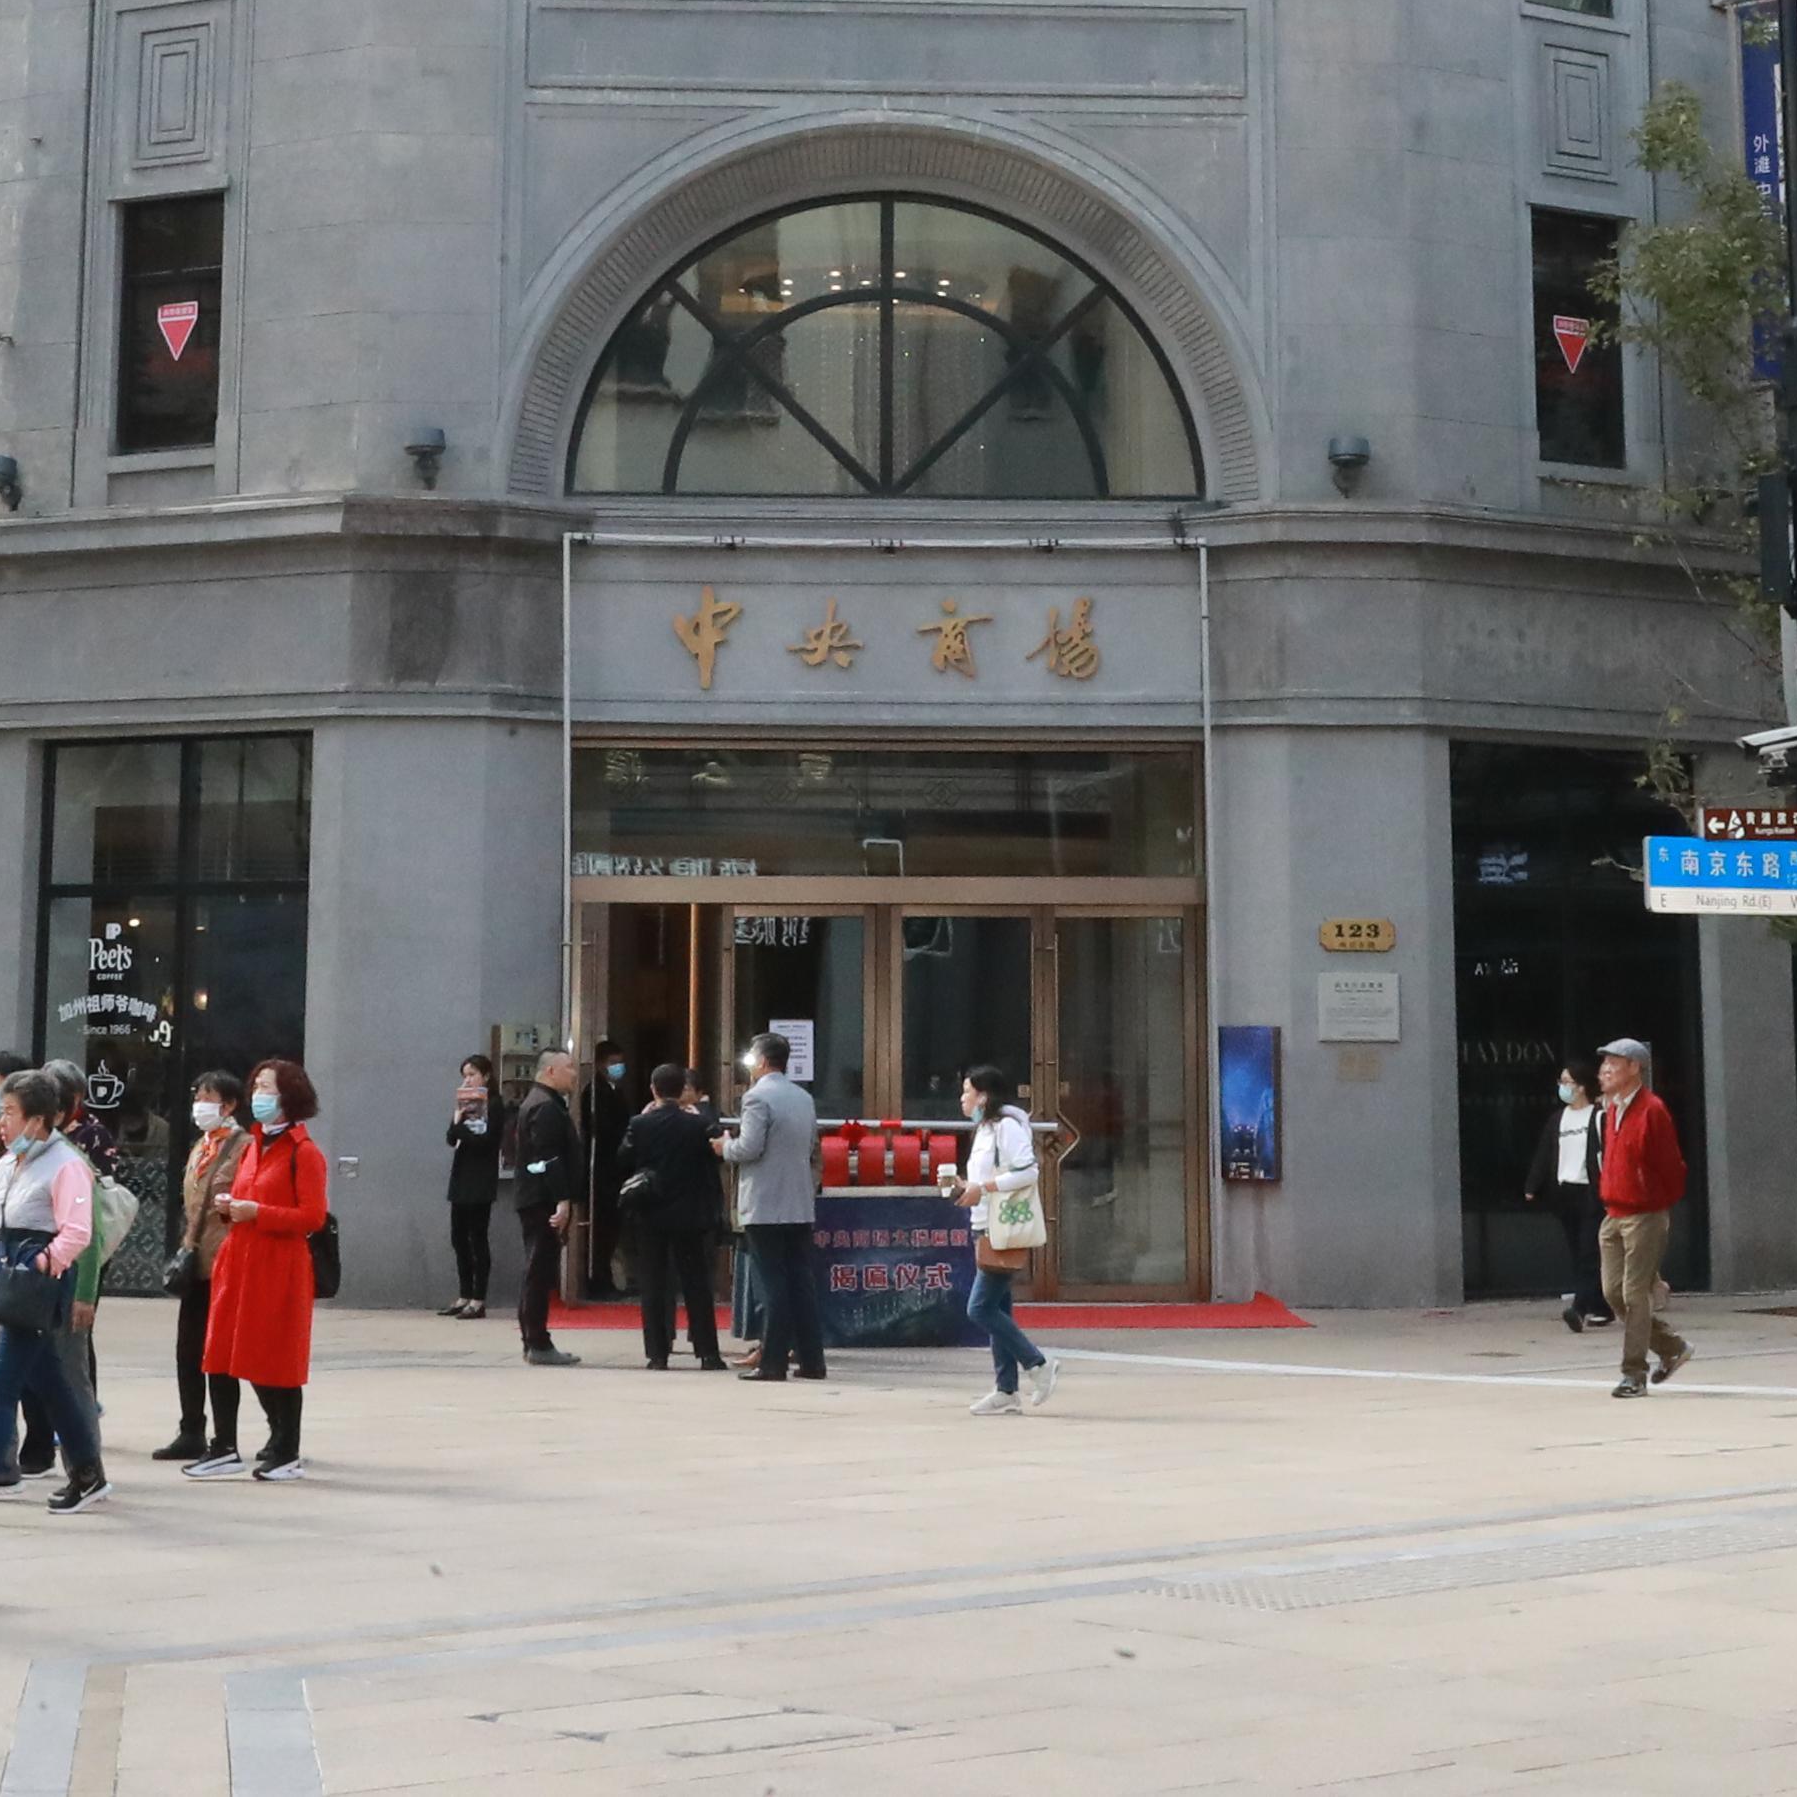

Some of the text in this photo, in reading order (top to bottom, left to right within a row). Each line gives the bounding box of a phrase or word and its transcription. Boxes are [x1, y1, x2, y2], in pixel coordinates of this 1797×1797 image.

[1658, 847, 1669, 863] 东
[1680, 849, 1780, 879] 南京东路
[1696, 894, 1737, 910] Nanjing
[1335, 923, 1381, 938] 123
[88, 938, 133, 971] Peet's
